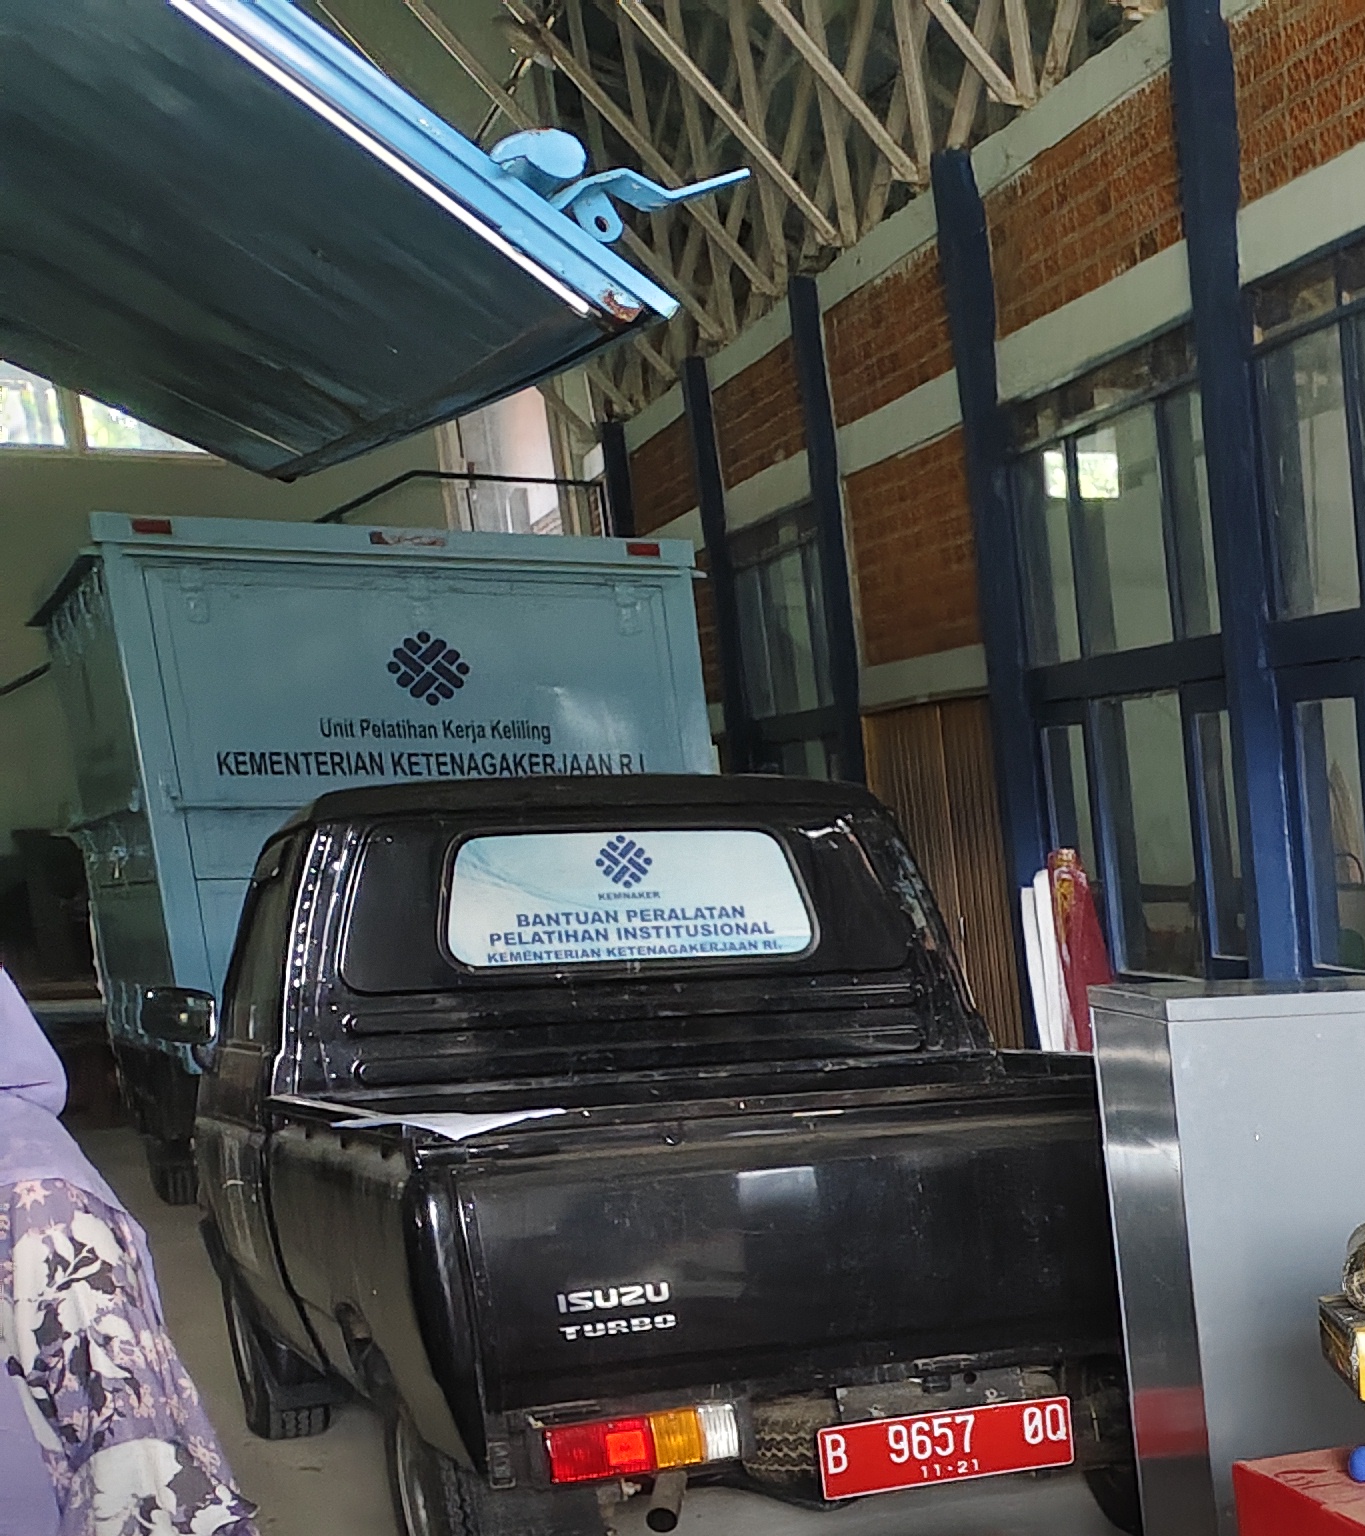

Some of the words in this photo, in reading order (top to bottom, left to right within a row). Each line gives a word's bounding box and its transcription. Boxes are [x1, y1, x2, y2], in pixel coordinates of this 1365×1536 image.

[319, 717, 356, 739] Unit
[359, 717, 438, 741] Pelatihan
[442, 718, 487, 745] Kerja
[490, 718, 552, 745] Keliling
[216, 751, 385, 777] KEMENTERIAN
[392, 751, 613, 777] KETENAGAKERJAAN
[597, 890, 661, 901] KEMNAKER
[516, 909, 620, 928] BANTUAN
[626, 905, 746, 924] PERALATAN
[489, 926, 610, 948] PELATIHAN
[616, 921, 775, 942] INSTITUSIONAL
[486, 946, 602, 965] KEMENTERIAN
[606, 941, 759, 958] KETENAGAKERJAAN
[556, 1281, 670, 1314] ISUZU
[559, 1312, 677, 1341] TURBO
[824, 1433, 848, 1475] B
[888, 1414, 976, 1464] 9657
